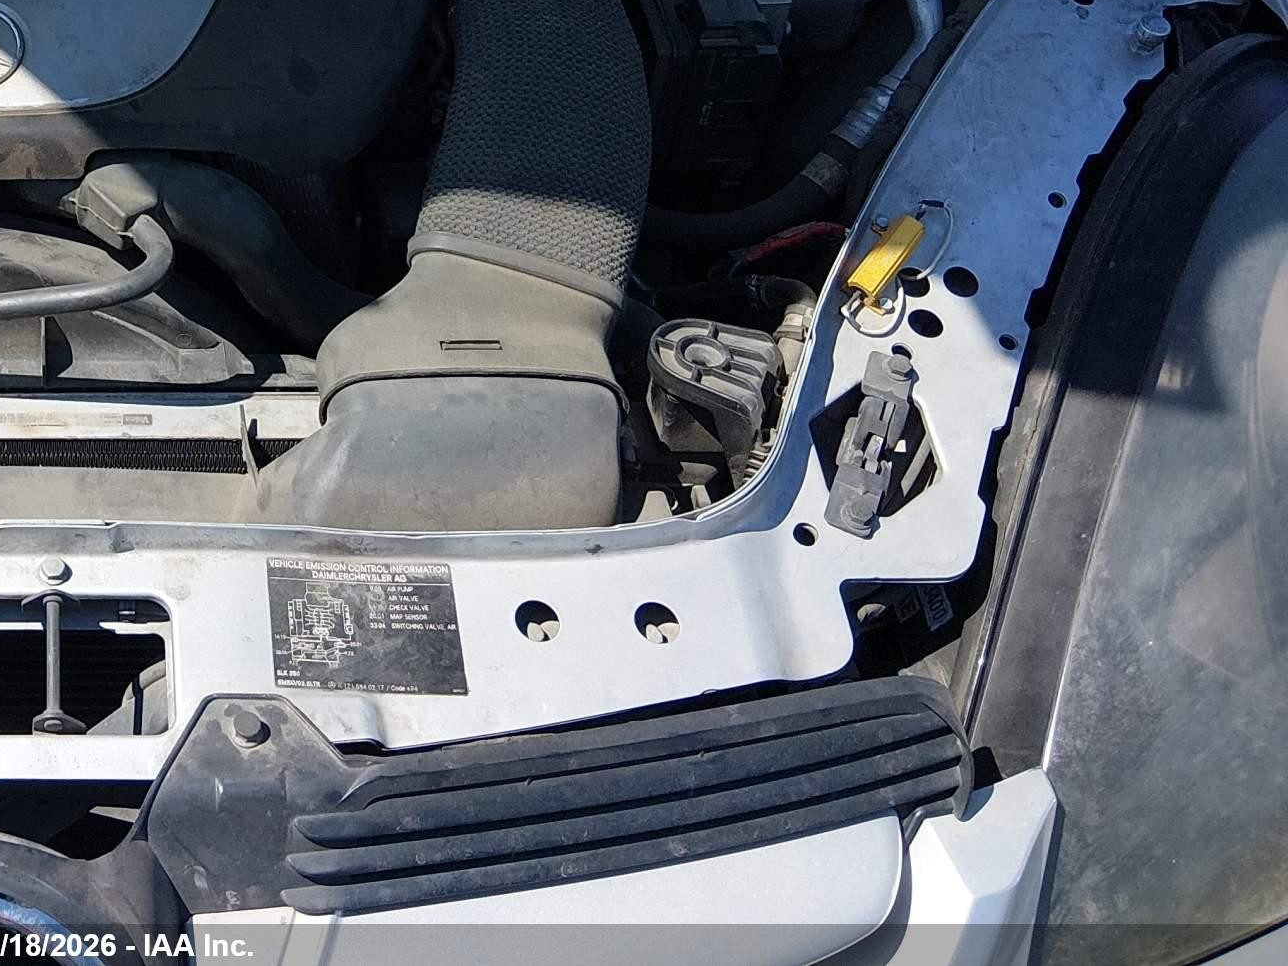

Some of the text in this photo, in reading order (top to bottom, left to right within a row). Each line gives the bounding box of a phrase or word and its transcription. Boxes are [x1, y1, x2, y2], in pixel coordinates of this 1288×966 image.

[269, 559, 448, 574] VEHICLE EMISSION CONTROL INFORMATION
[312, 572, 407, 582] DAIMLERCHRYSLER AG
